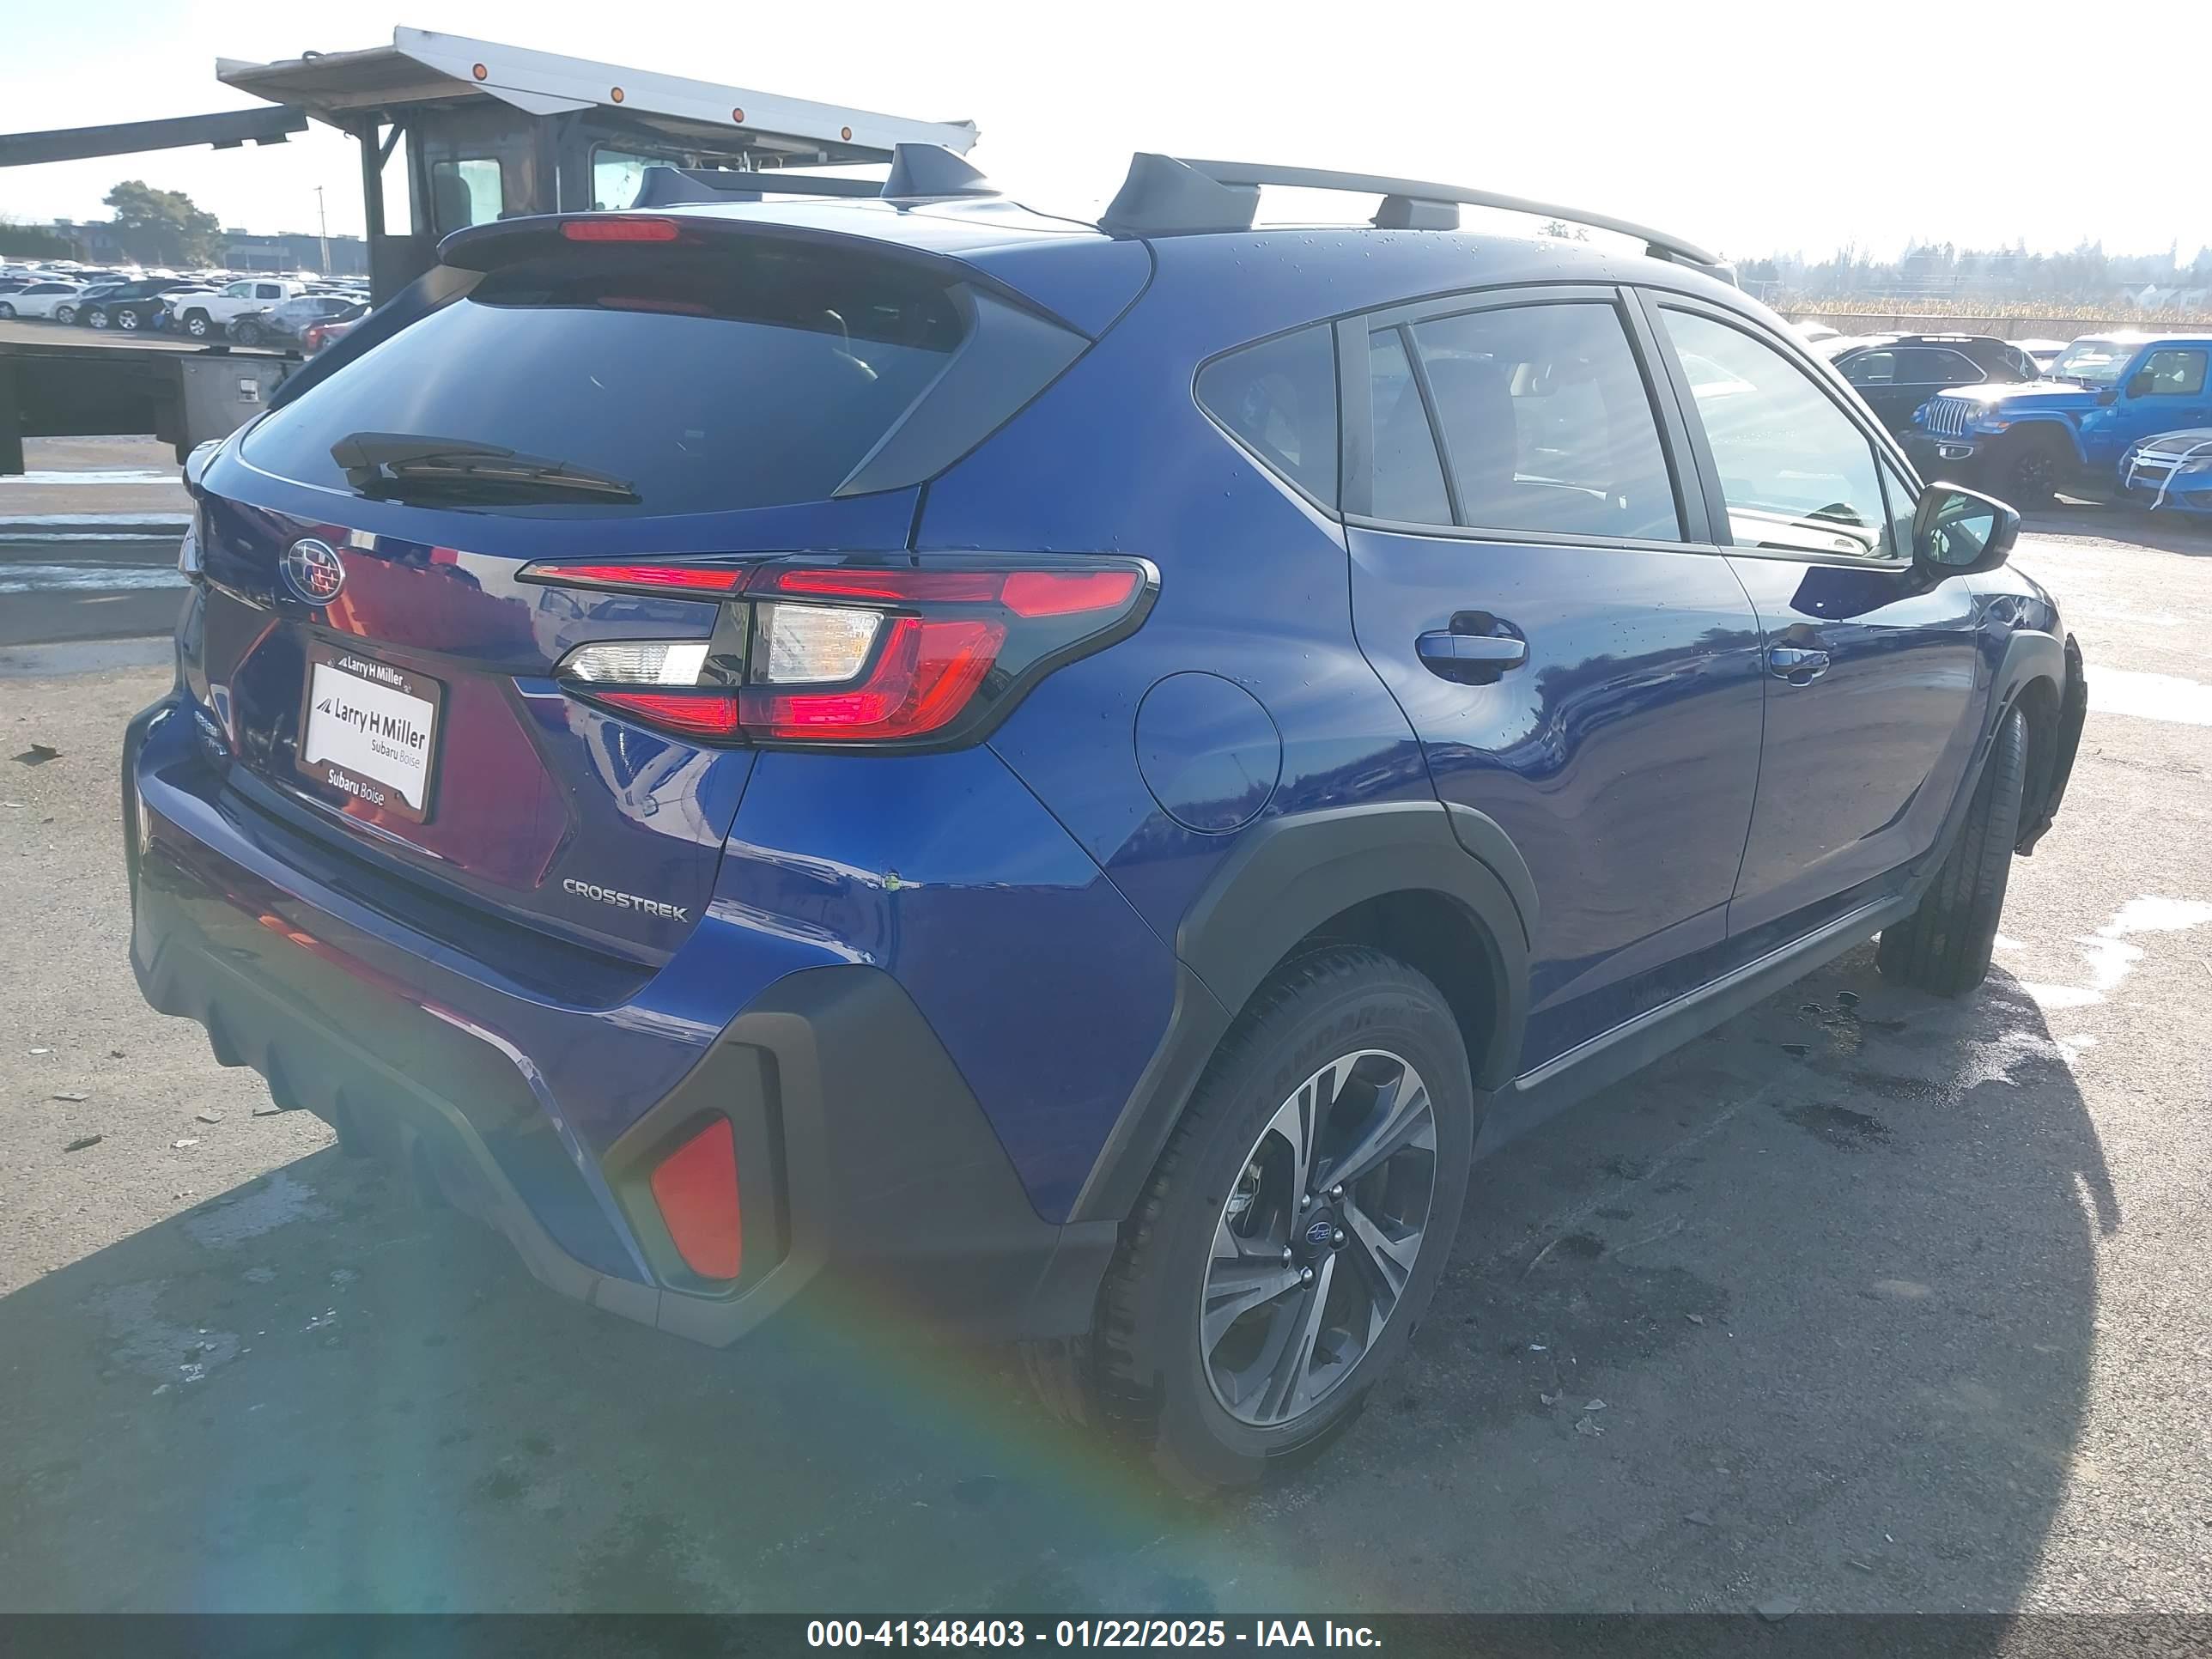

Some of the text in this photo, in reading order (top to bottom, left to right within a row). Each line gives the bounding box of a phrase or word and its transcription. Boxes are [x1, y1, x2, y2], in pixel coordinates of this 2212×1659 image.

[349, 657, 403, 686] Larry H Miller
[335, 698, 425, 749] Larry H Miller
[371, 738, 421, 769] Subaru Boise
[328, 769, 385, 806] Subaru Boise
[562, 878, 689, 924] CROSSTREK
